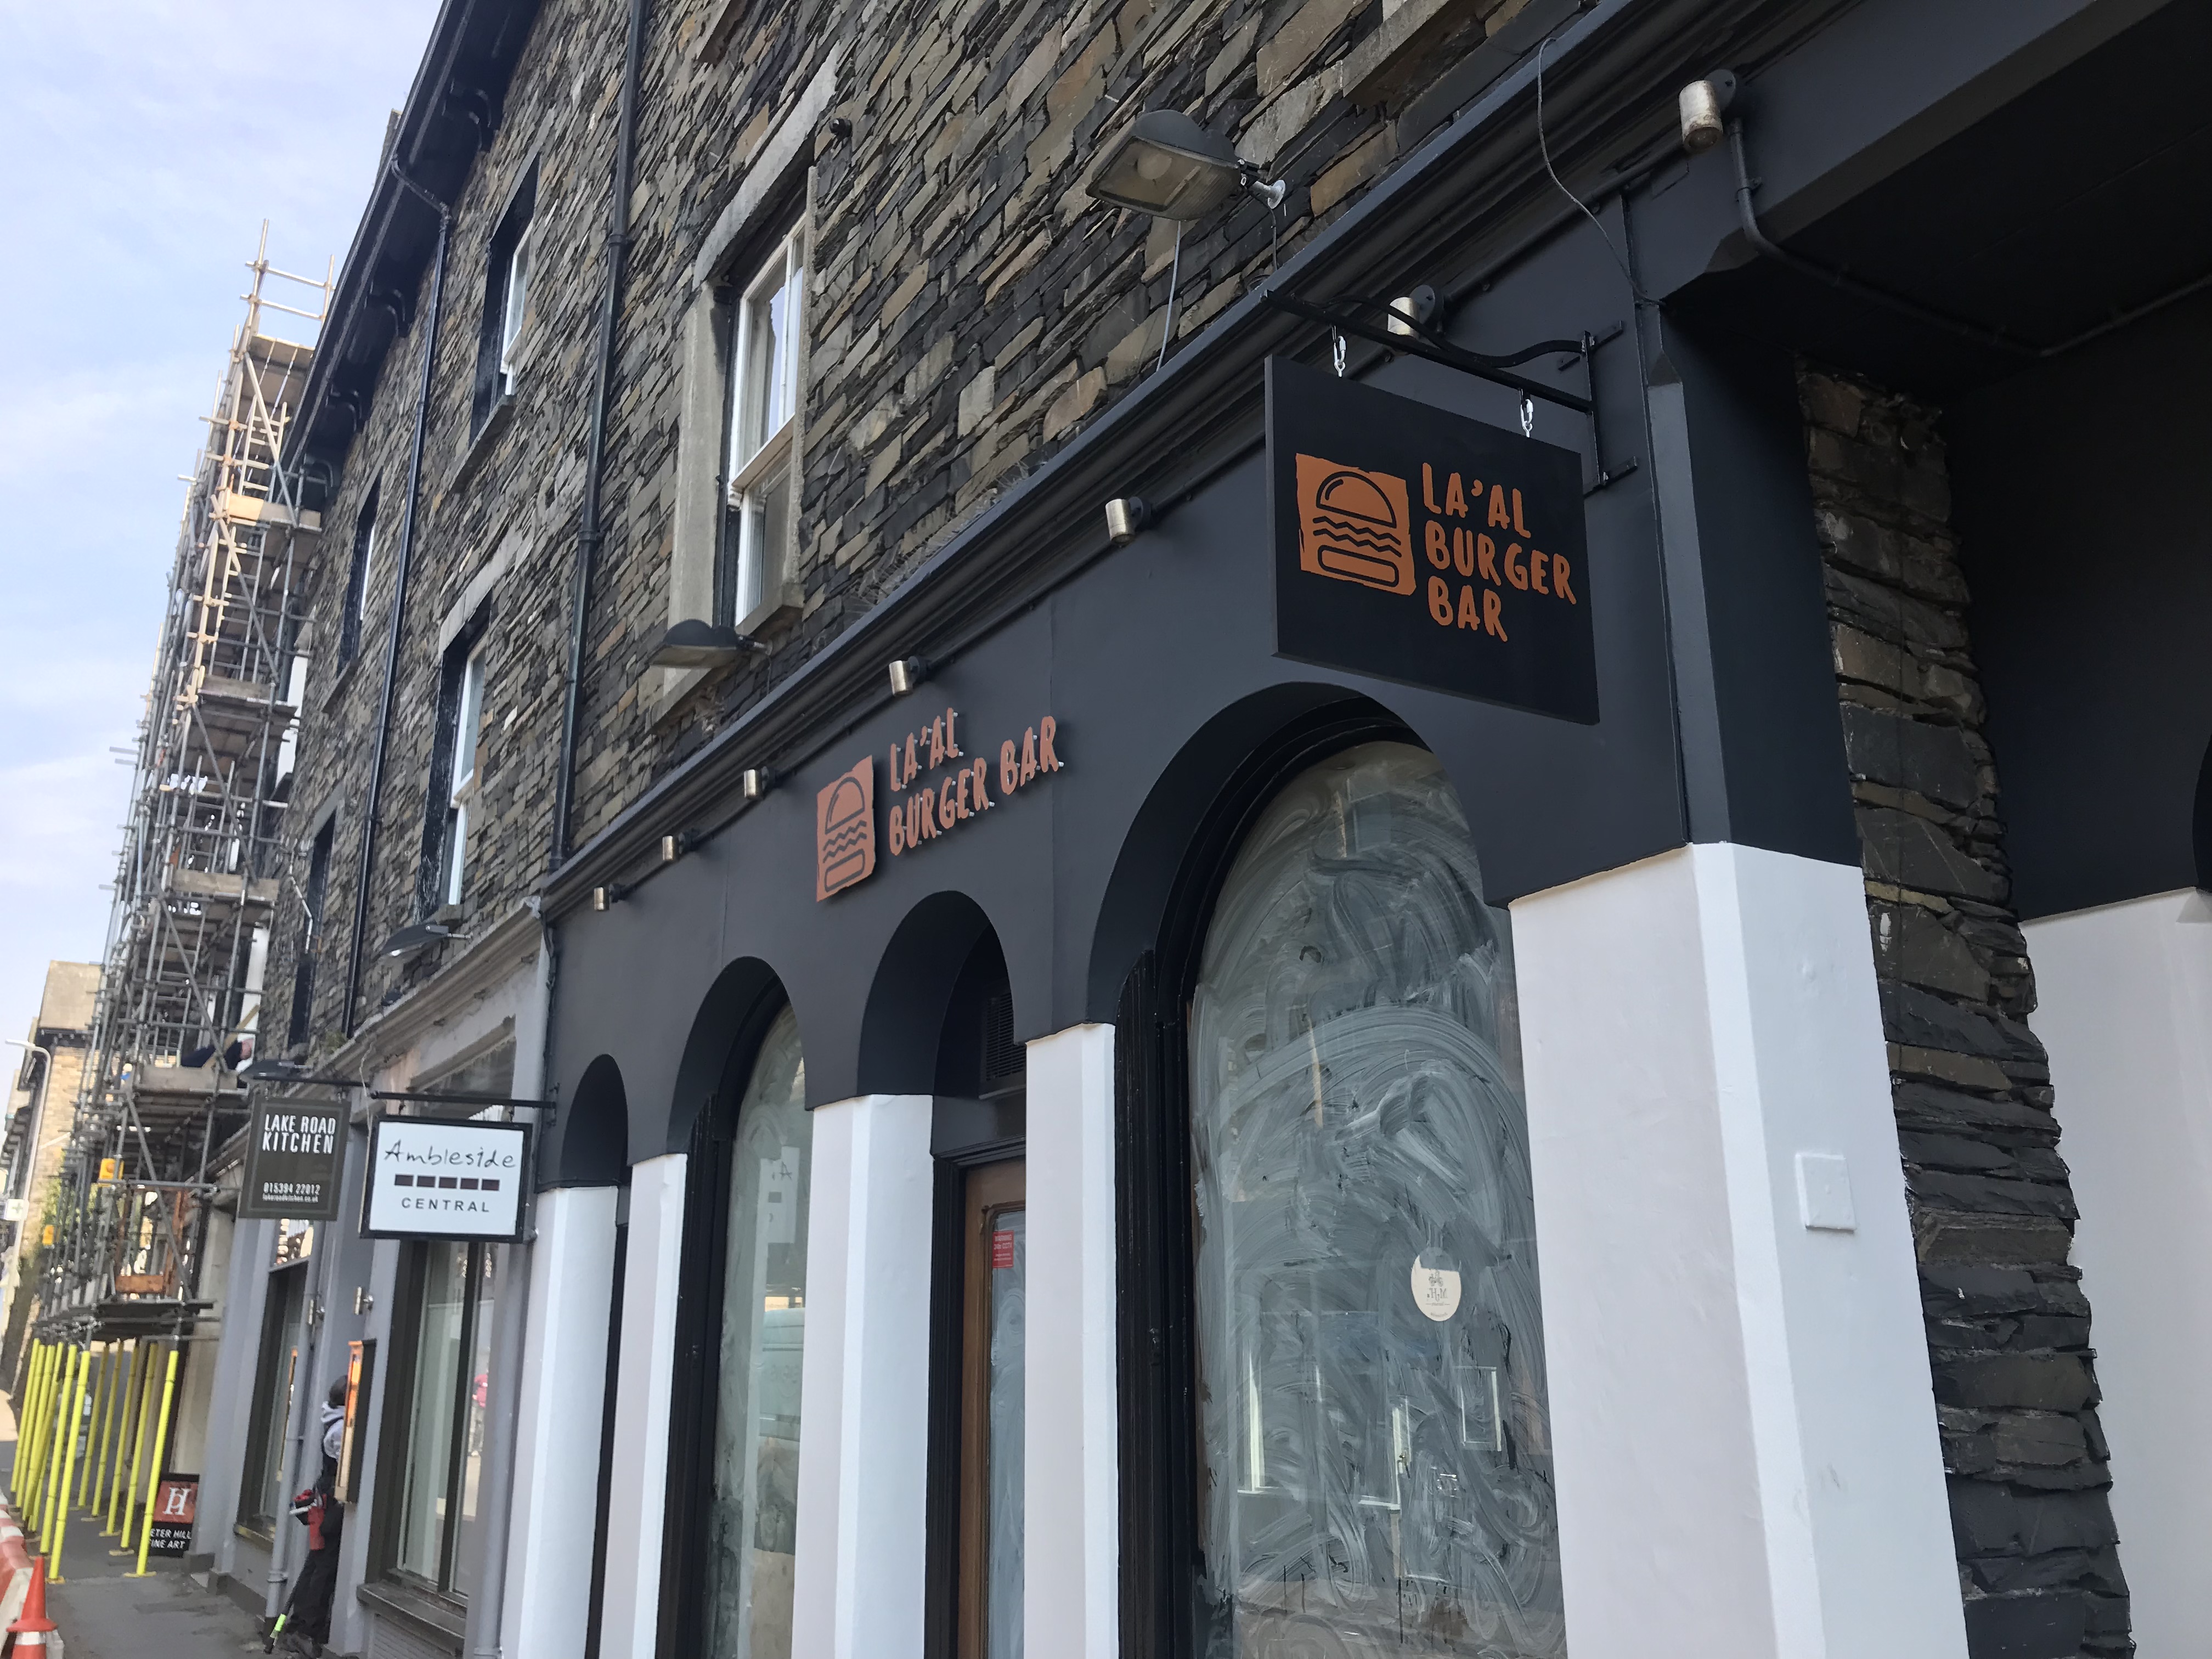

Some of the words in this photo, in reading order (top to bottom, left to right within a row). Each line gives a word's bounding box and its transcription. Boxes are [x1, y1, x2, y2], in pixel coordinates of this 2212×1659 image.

[1422, 462, 1531, 539] LA'AL
[1425, 520, 1577, 605] BURGER
[1427, 575, 1508, 642] BAR
[890, 707, 959, 792] LA'AL
[889, 757, 989, 856] BURGER
[1000, 715, 1059, 795] BAR
[264, 1114, 296, 1133] LAKE
[300, 1116, 336, 1135] ROAD
[262, 1131, 334, 1154] KITCHEN
[383, 1139, 517, 1169] Ambleside
[401, 1198, 490, 1213] CENTRAL
[149, 1539, 166, 1549] INE
[167, 1540, 185, 1549] ART
[150, 1528, 172, 1538] ETER
[173, 1530, 192, 1539] HILL
